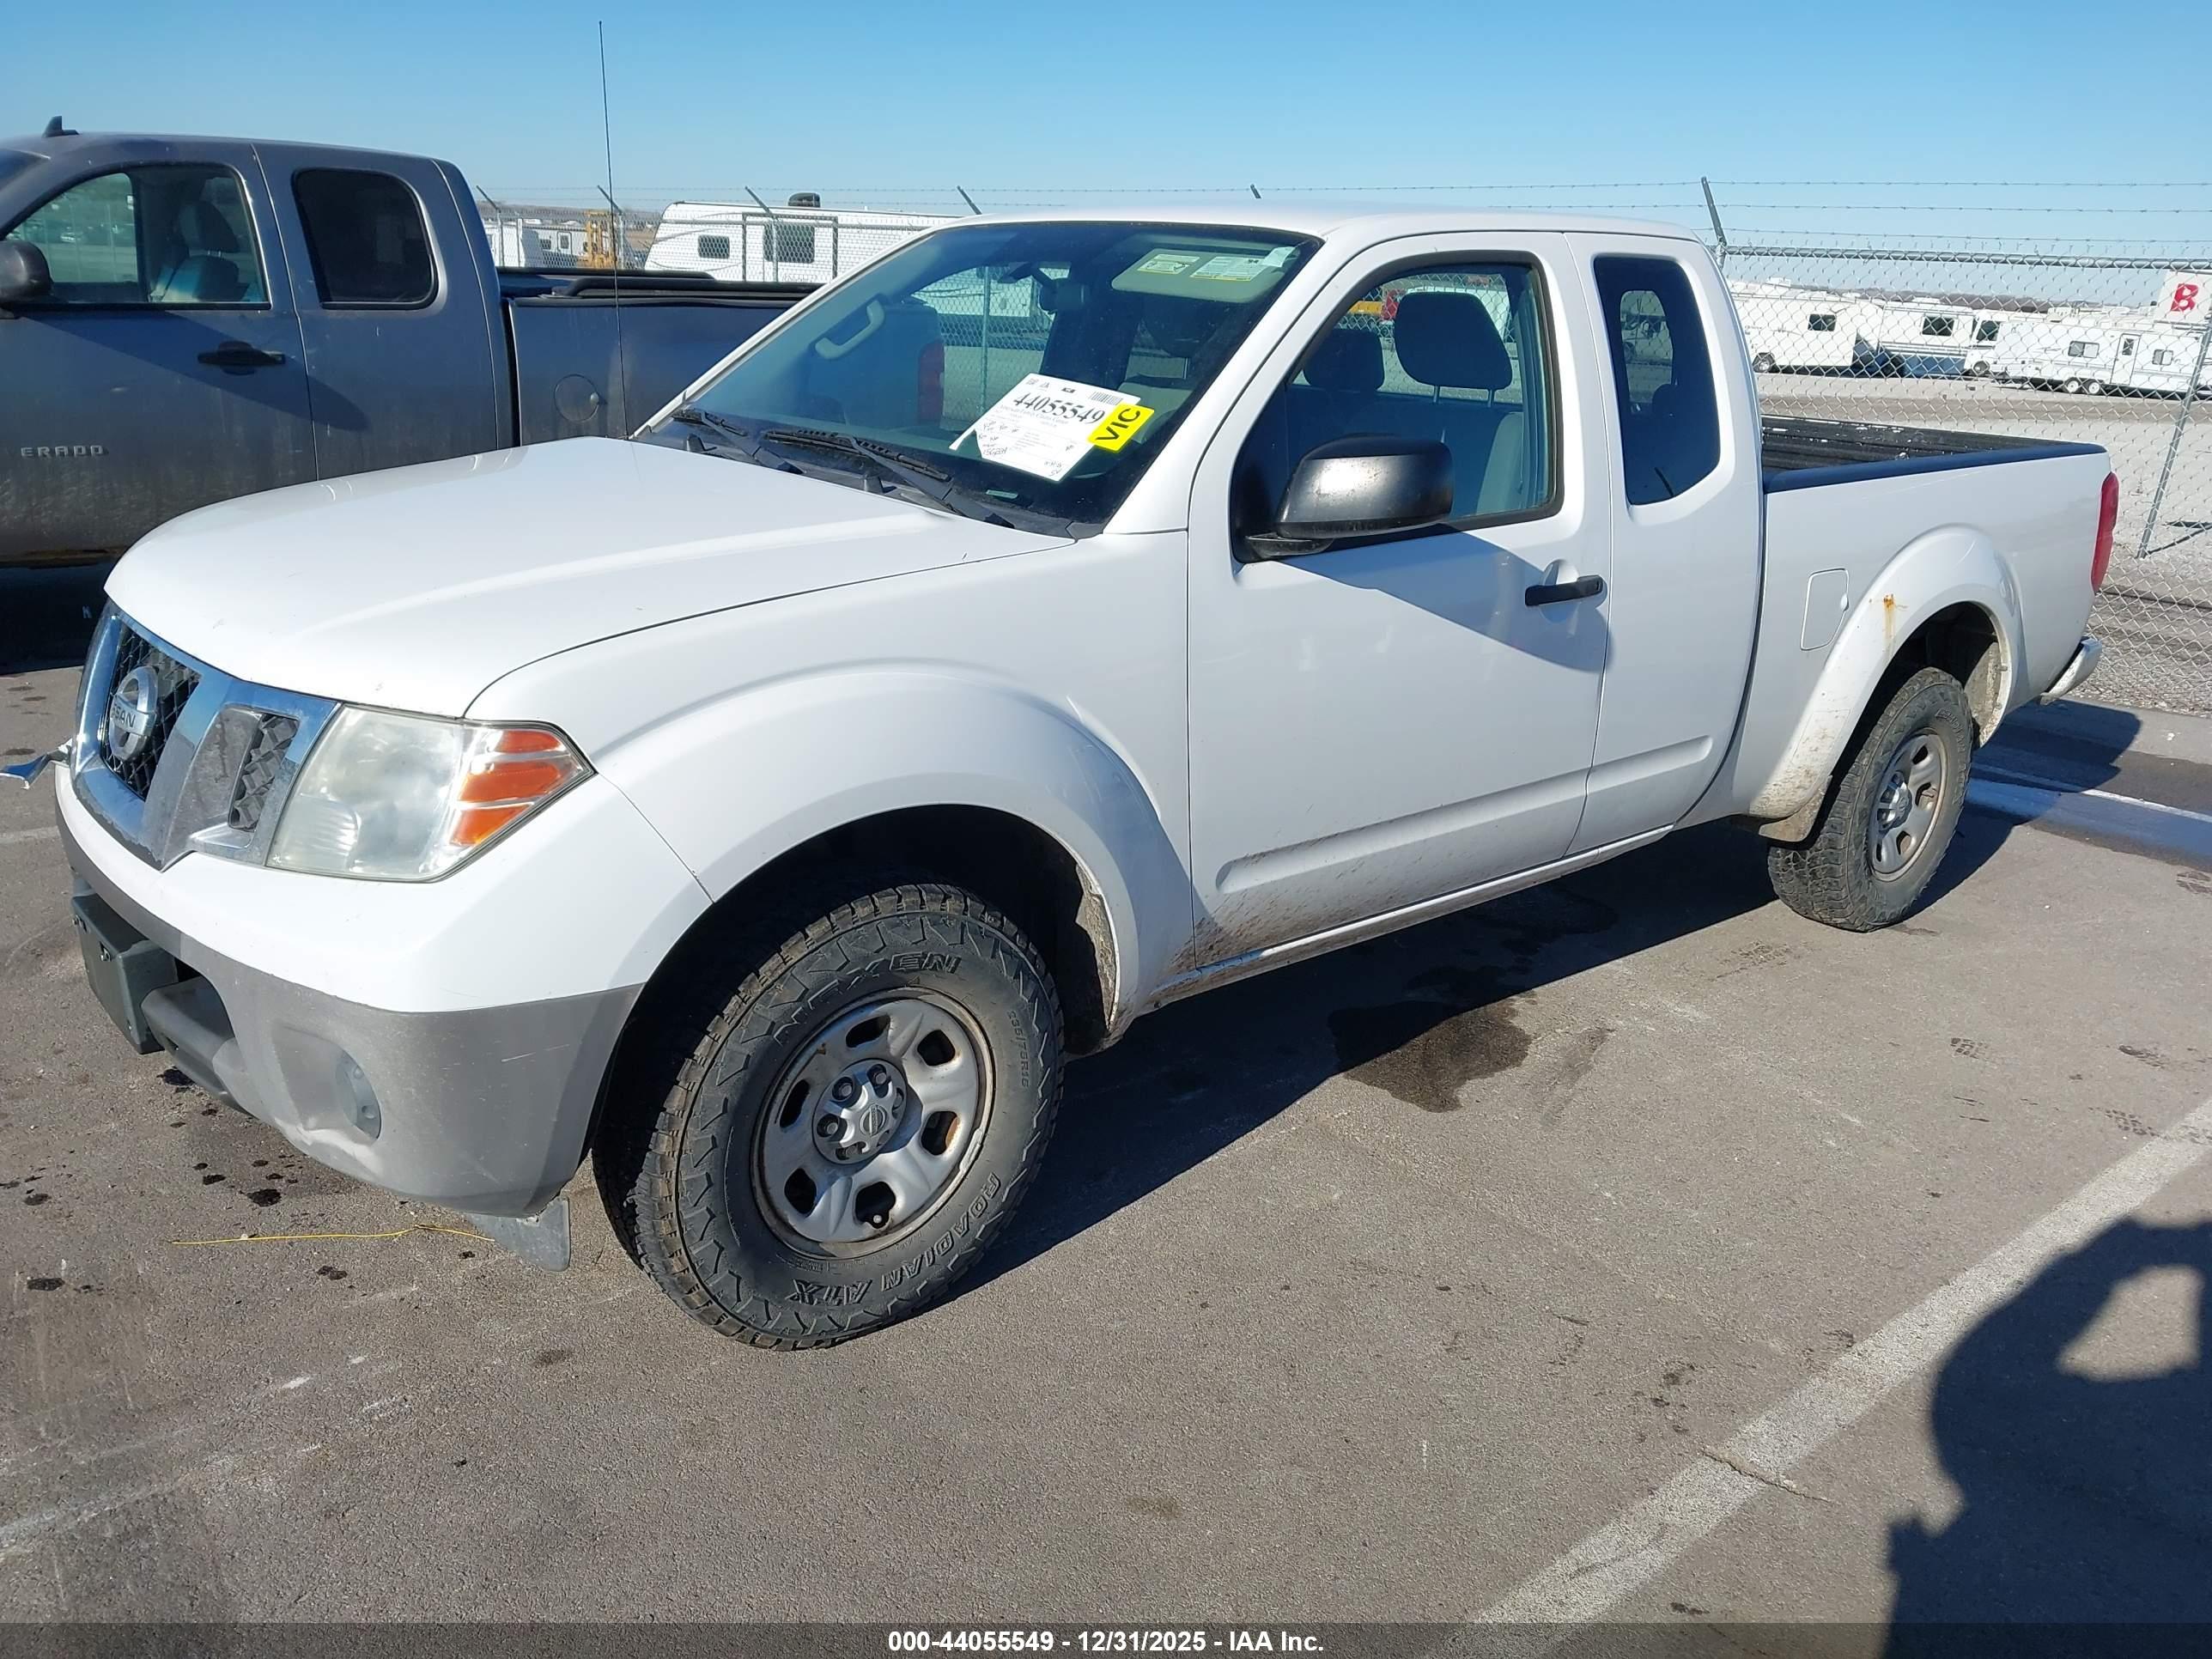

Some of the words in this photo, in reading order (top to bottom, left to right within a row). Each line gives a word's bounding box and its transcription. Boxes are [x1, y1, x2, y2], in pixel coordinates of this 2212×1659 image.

[2170, 283, 2199, 312] B
[1012, 392, 1106, 424] 44055549
[1095, 407, 1141, 442] VIC
